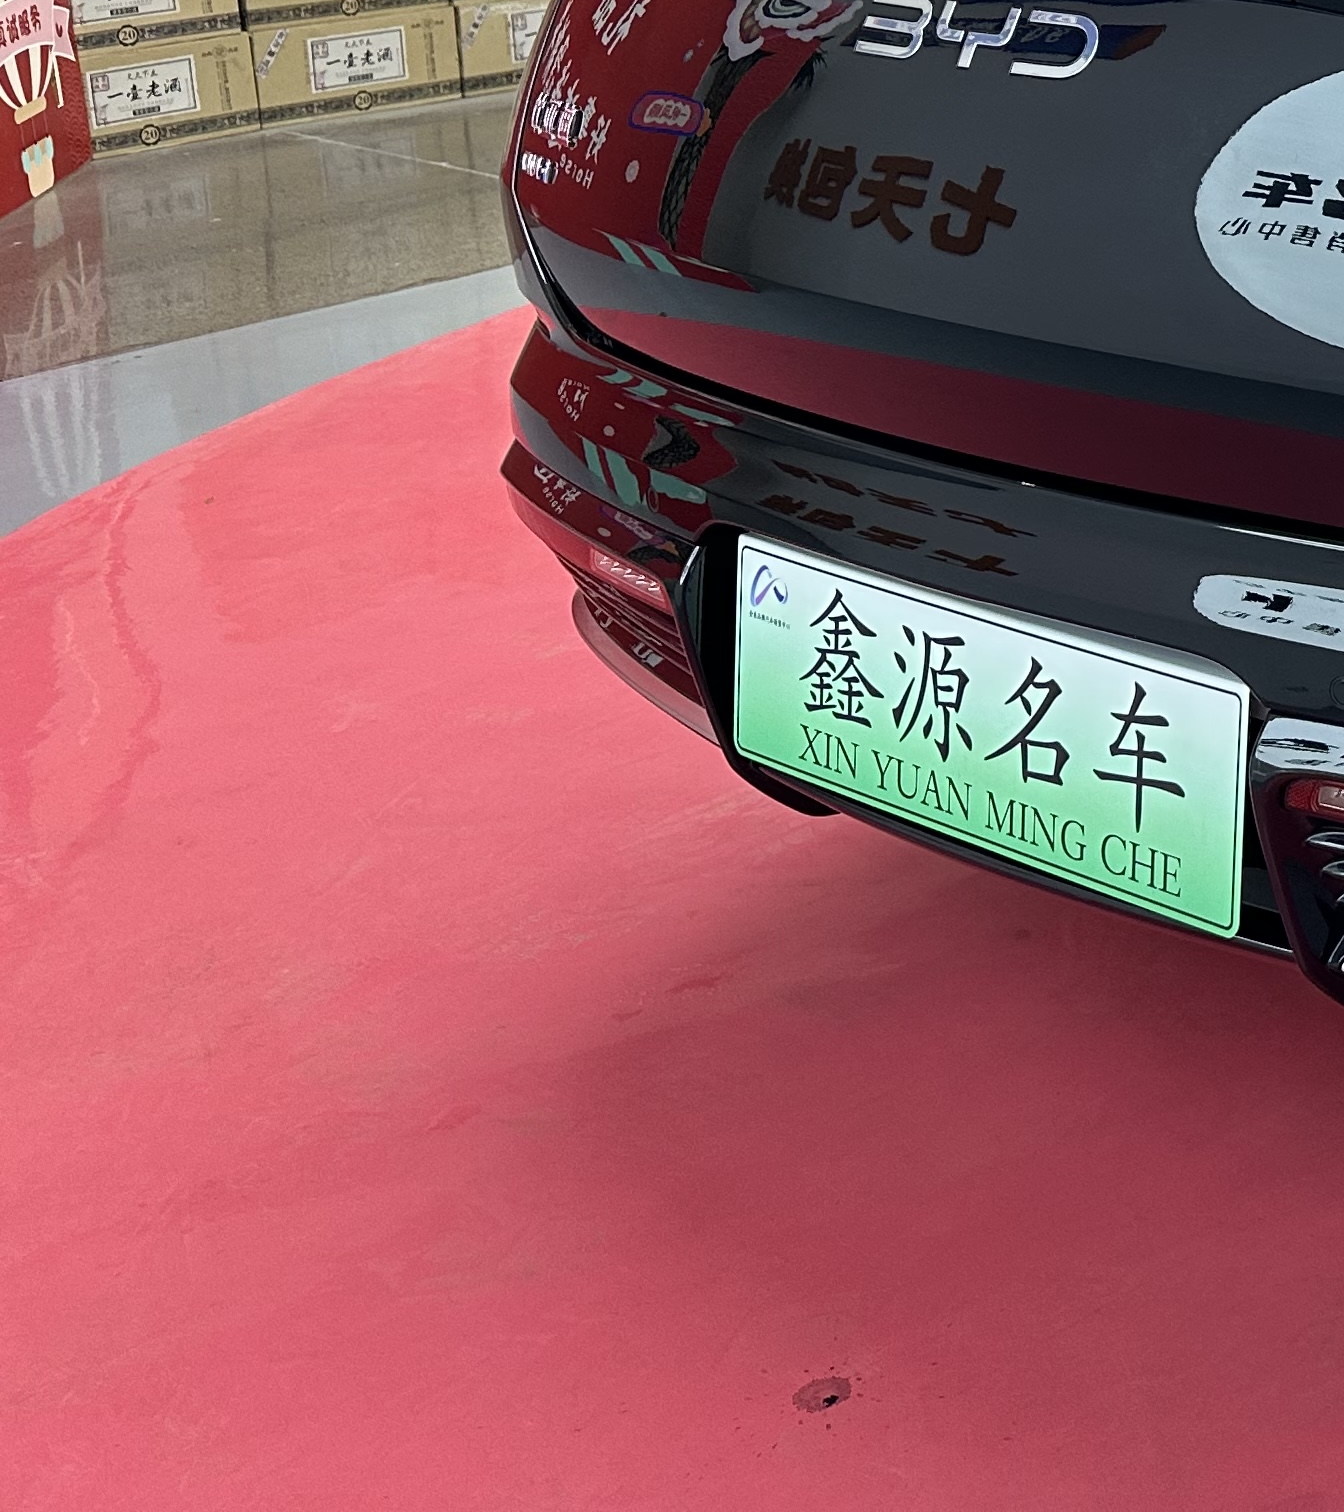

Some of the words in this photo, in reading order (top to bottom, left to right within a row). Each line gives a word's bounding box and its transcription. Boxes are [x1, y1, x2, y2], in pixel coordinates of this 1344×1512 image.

[799, 723, 859, 779] XIN
[872, 749, 972, 822] YUAN
[985, 789, 1087, 863] MING
[1101, 833, 1182, 898] CHE
[800, 589, 1186, 834] 鑫源名车
